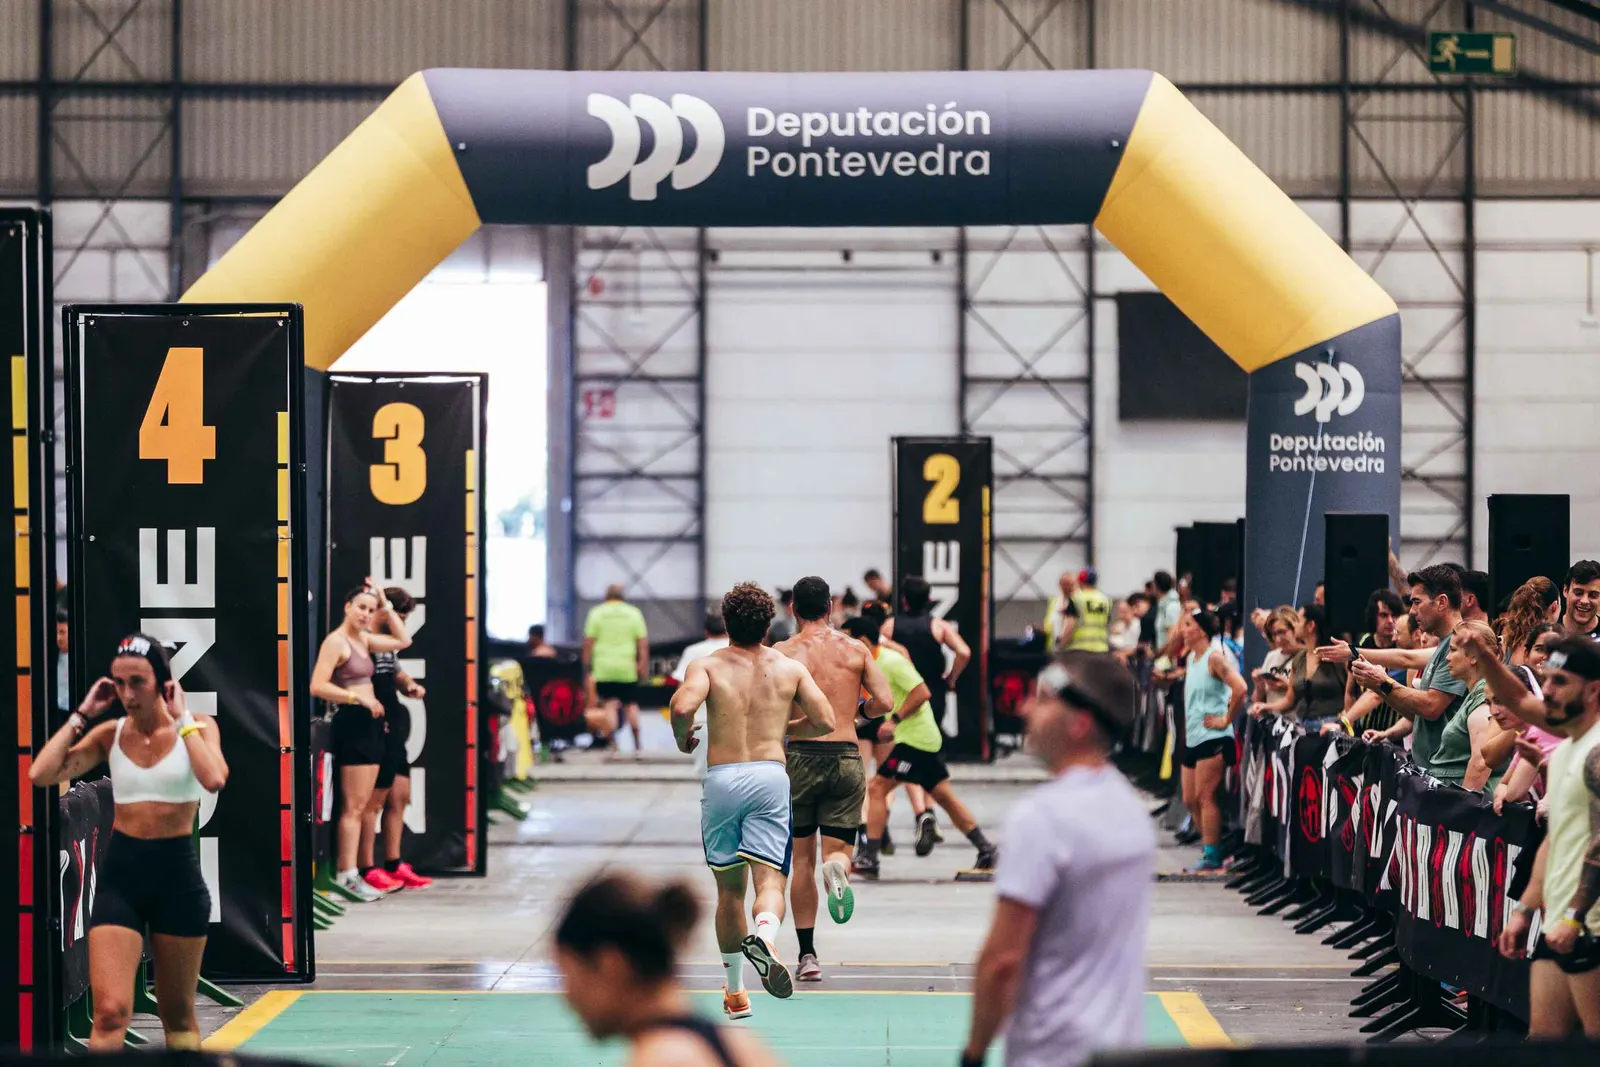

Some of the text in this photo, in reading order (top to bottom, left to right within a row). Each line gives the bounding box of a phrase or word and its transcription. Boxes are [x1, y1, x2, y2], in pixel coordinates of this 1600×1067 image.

[747, 101, 991, 147] Deputación
[747, 143, 991, 178] Pontevedra
[138, 347, 216, 485] 4
[369, 402, 427, 505] 3
[1269, 430, 1385, 455] Deputación
[1269, 453, 1385, 473] Pontevedra
[922, 453, 961, 524] 2
